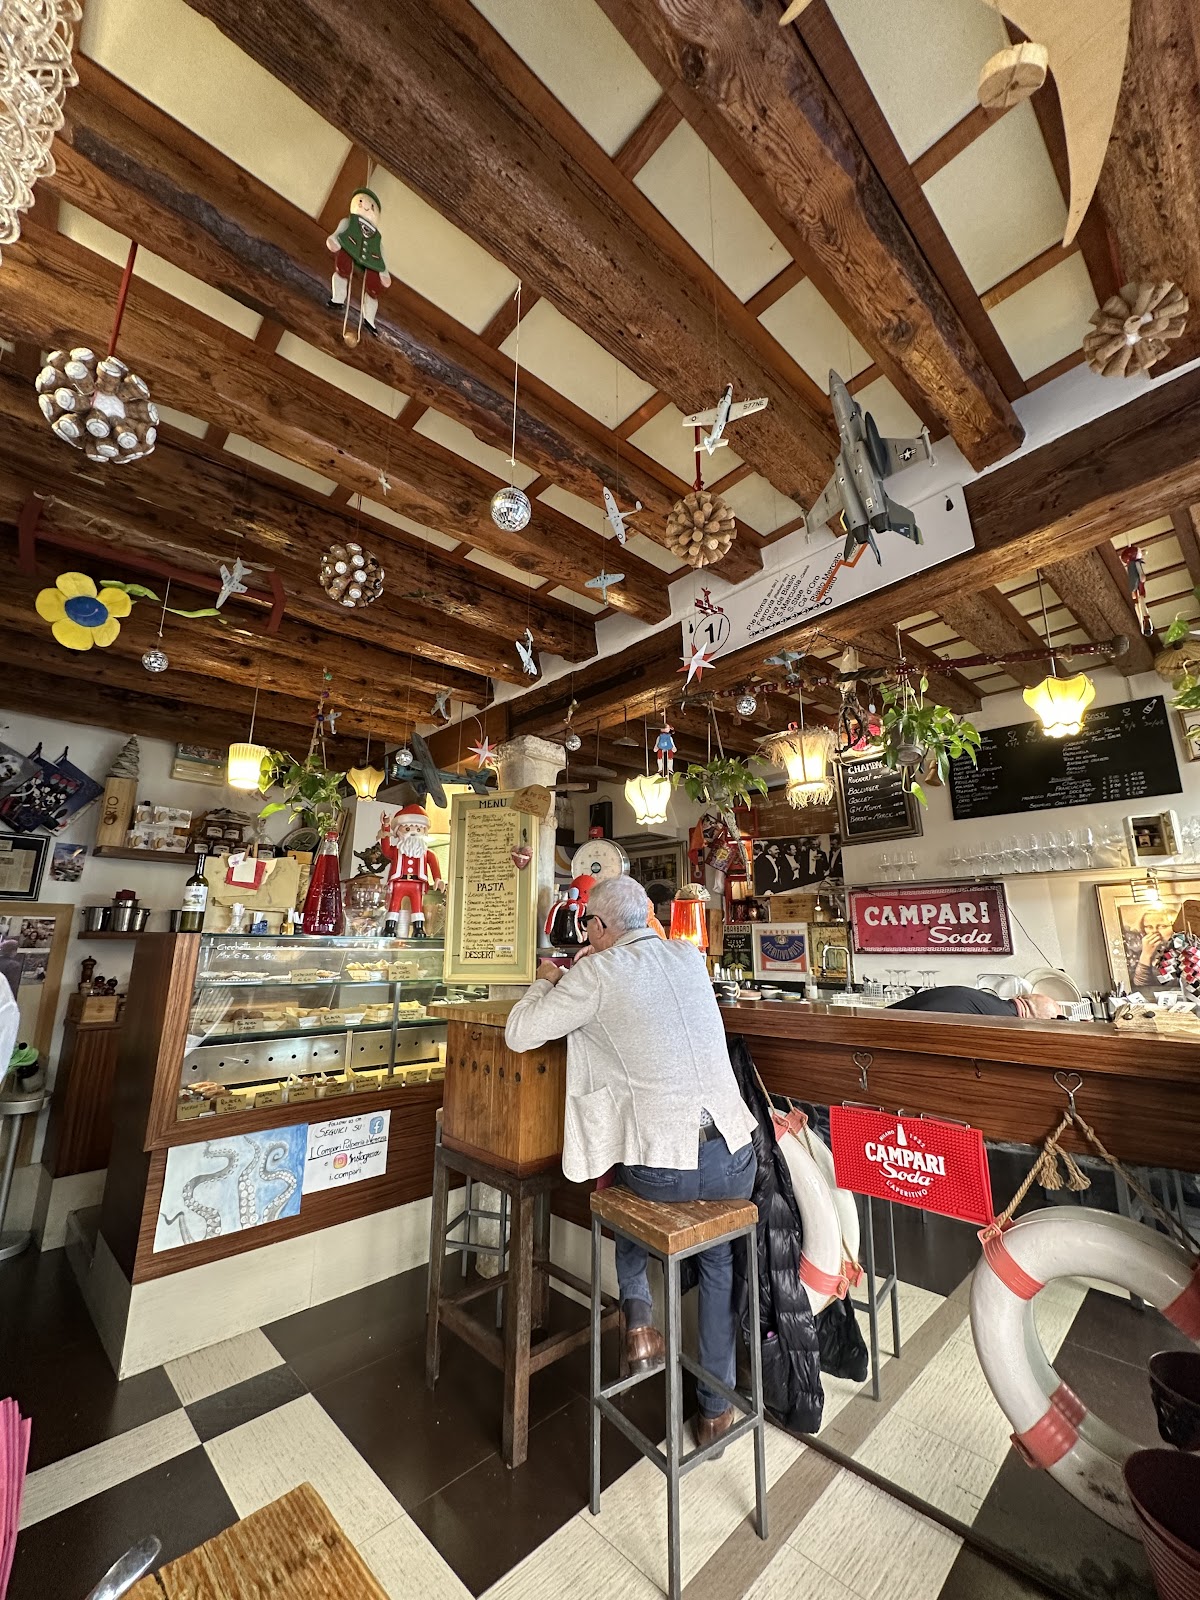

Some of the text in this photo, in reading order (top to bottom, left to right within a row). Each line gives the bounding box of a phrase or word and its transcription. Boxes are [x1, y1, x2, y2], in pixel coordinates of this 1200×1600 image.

[822, 552, 842, 581] Mercato
[754, 598, 768, 618] Roma
[757, 600, 774, 626] Ferrovia
[767, 607, 778, 621] Riva
[479, 798, 507, 808] MENU
[477, 883, 505, 891] PASTA
[864, 902, 990, 926] CAMPARI
[928, 926, 992, 944] Soda
[315, 1127, 347, 1138] SEGUICI
[879, 1130, 895, 1141] MILANO
[910, 1133, 925, 1148] 1932
[864, 1142, 946, 1176] CAMPARI
[878, 1161, 932, 1186] Soda
[886, 1180, 928, 1198] L'APERITIVO
